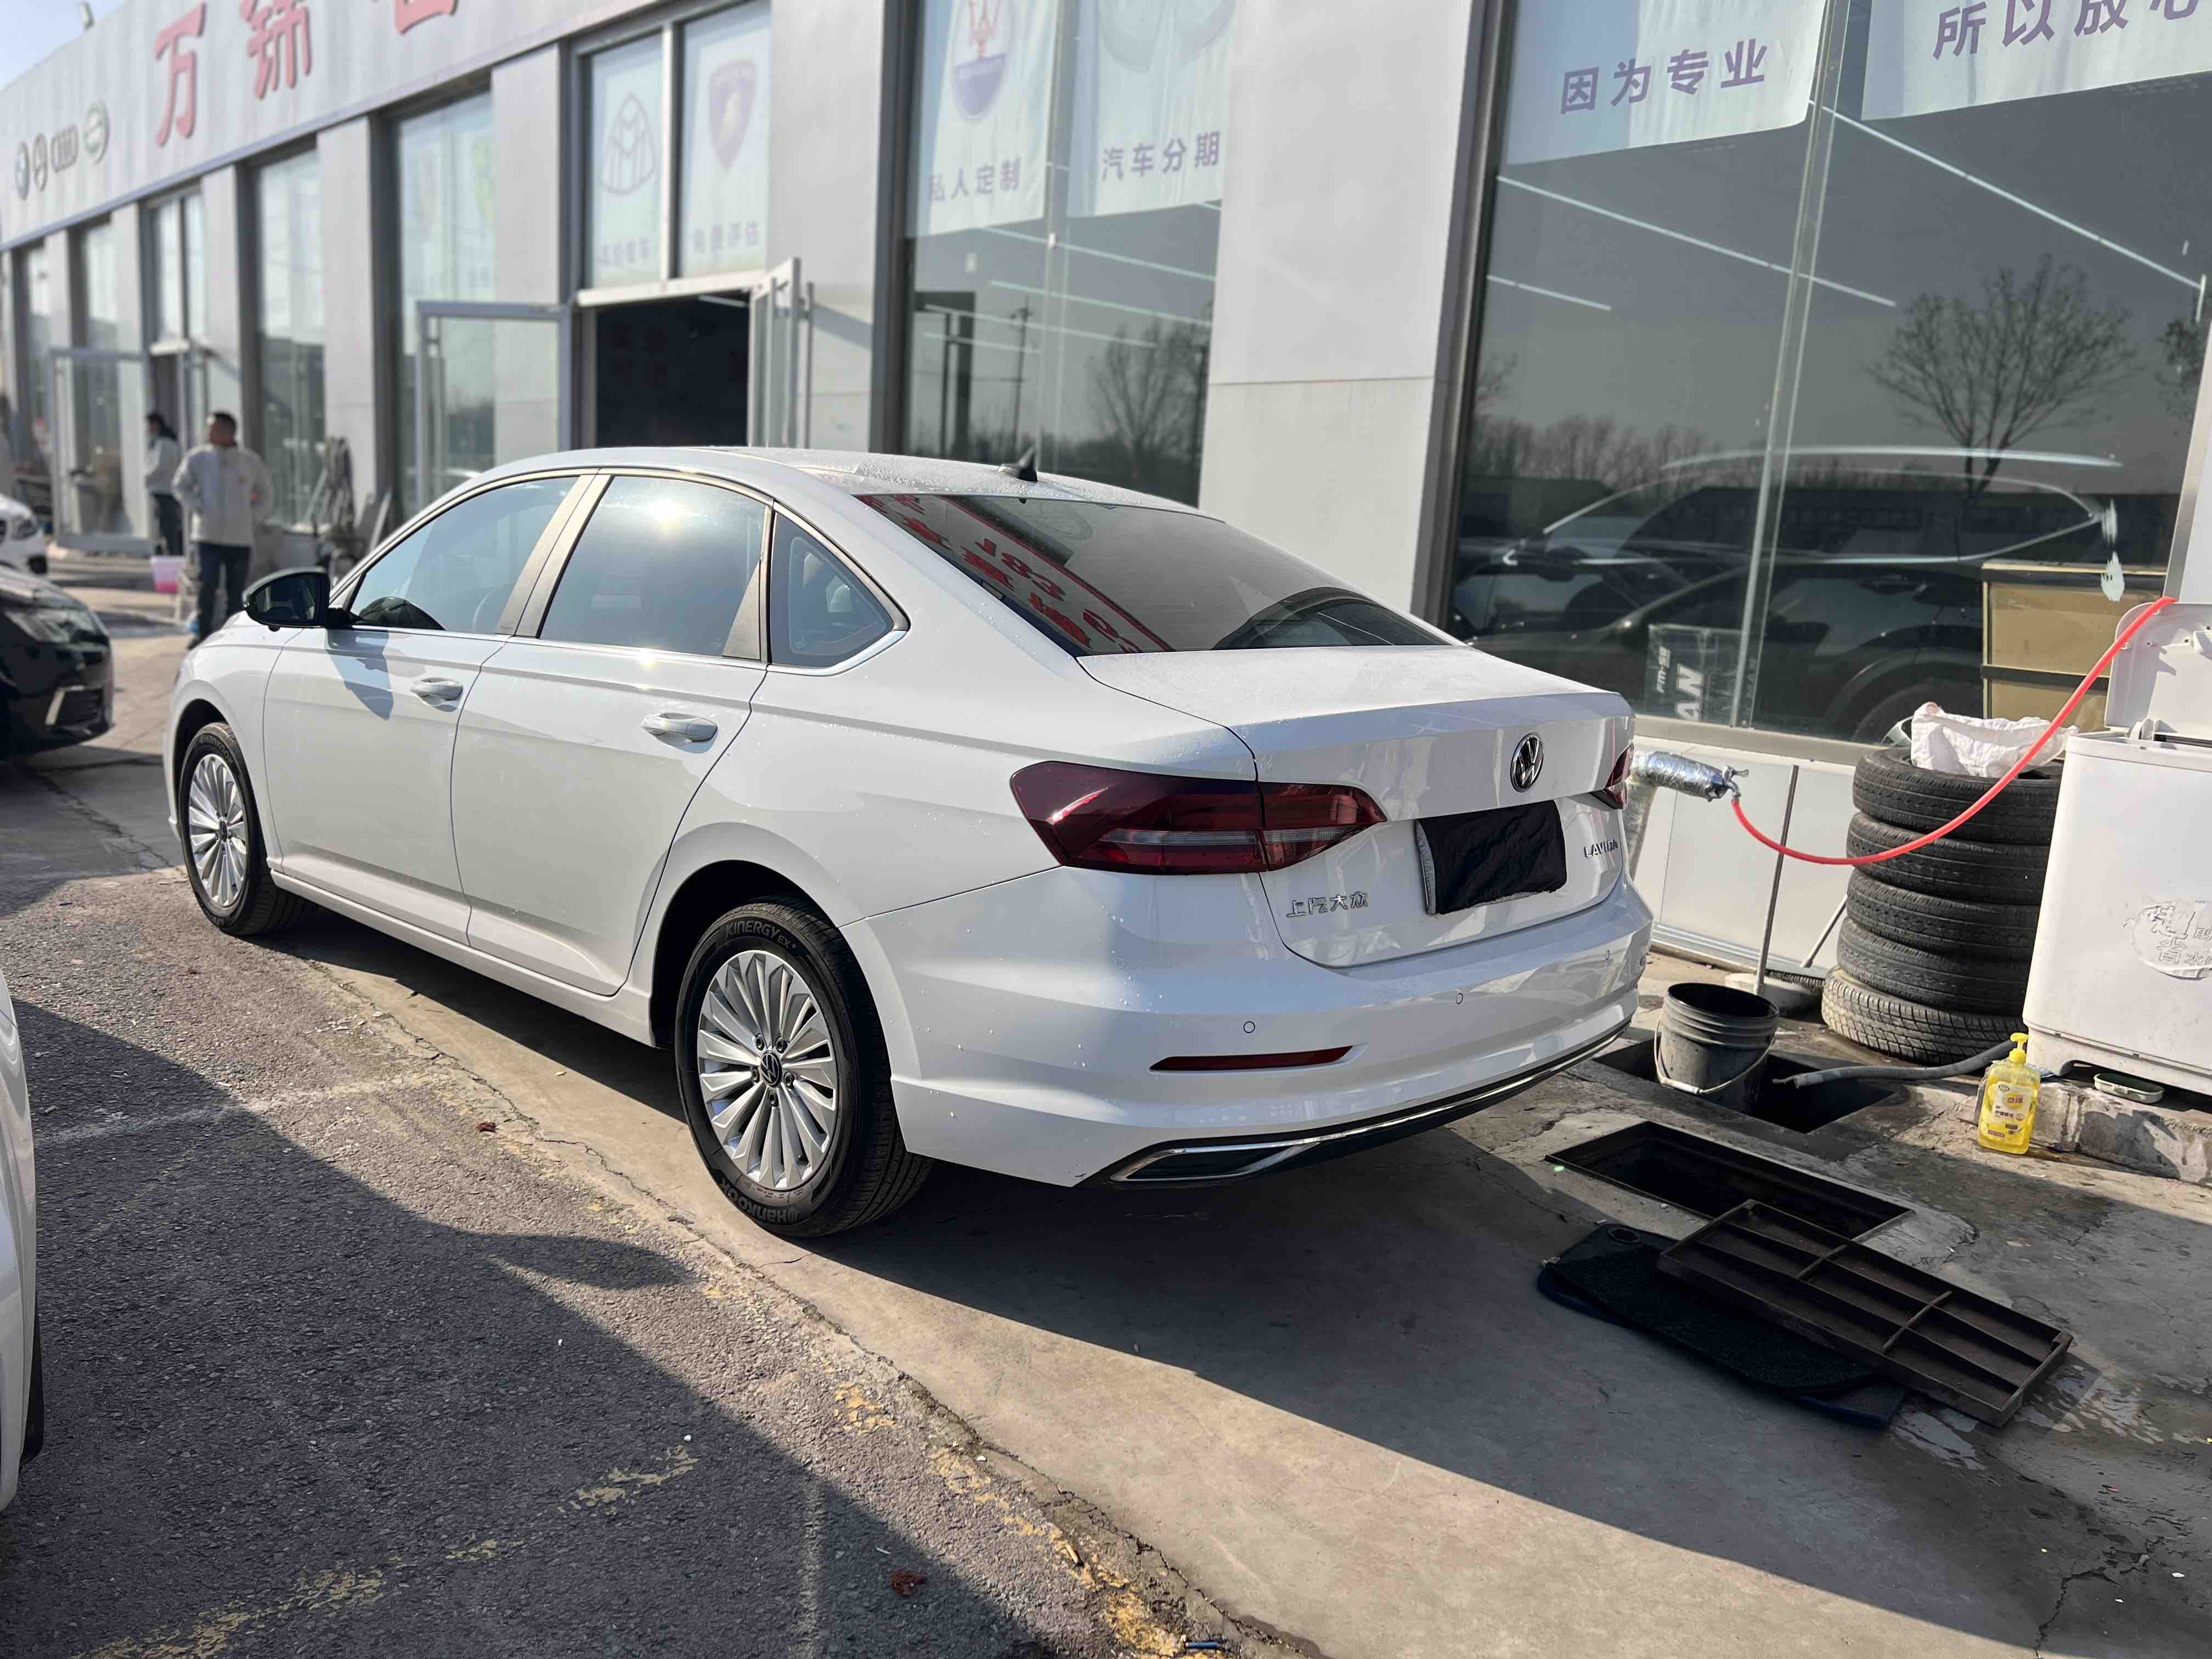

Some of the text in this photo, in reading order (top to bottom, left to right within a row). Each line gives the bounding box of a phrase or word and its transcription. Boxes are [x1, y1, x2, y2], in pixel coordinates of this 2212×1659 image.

[154, 0, 459, 148] 万锦
[1561, 38, 1768, 115] 因为专业
[929, 157, 1022, 202] 私人定制
[1102, 131, 1221, 182] 汽车分期
[1286, 891, 1369, 918] 上汽大众
